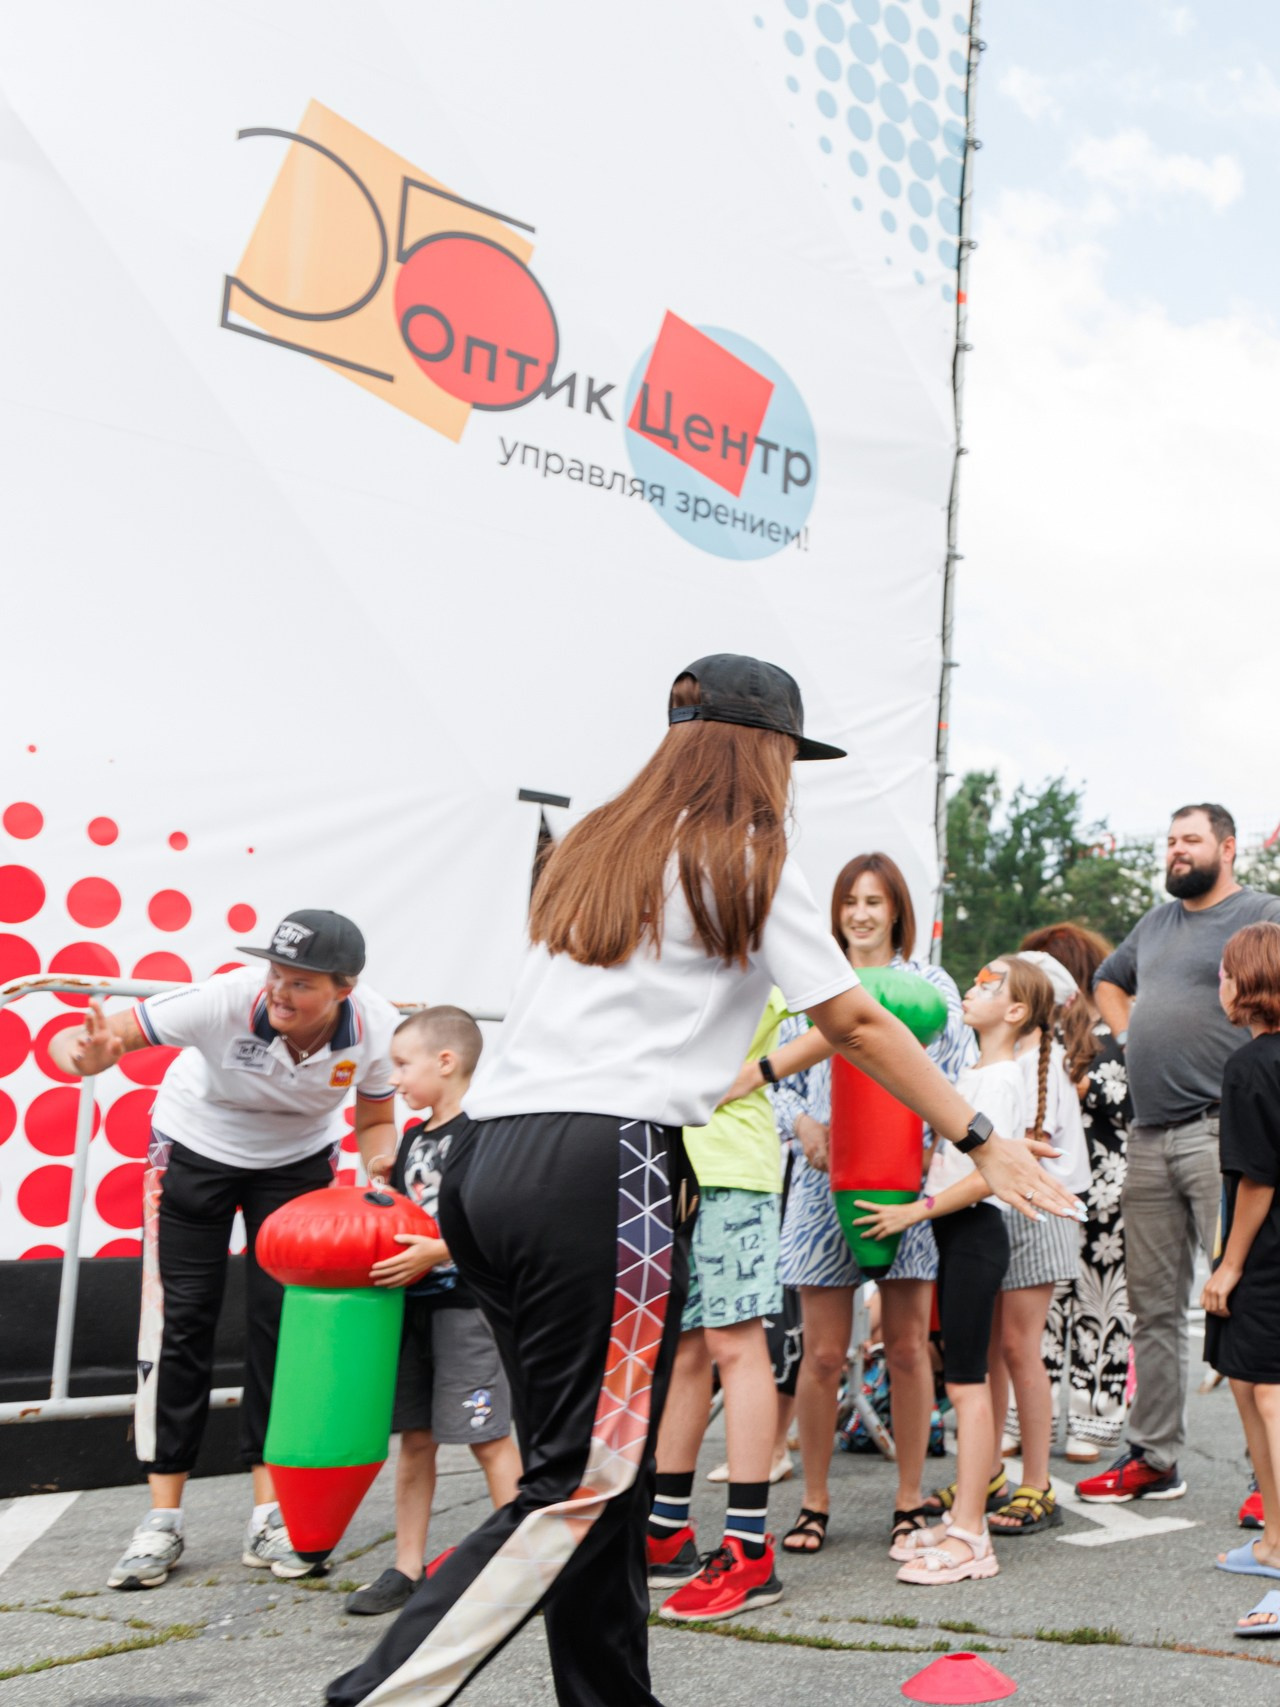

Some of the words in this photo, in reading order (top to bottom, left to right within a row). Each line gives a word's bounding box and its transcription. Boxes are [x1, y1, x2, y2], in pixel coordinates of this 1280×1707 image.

[220, 127, 559, 411] 25
[400, 303, 617, 421] Оптик
[638, 382, 812, 494] Центр
[498, 435, 665, 508] управляя
[674, 489, 810, 552] зрением!
[739, 1233, 760, 1252] 12
